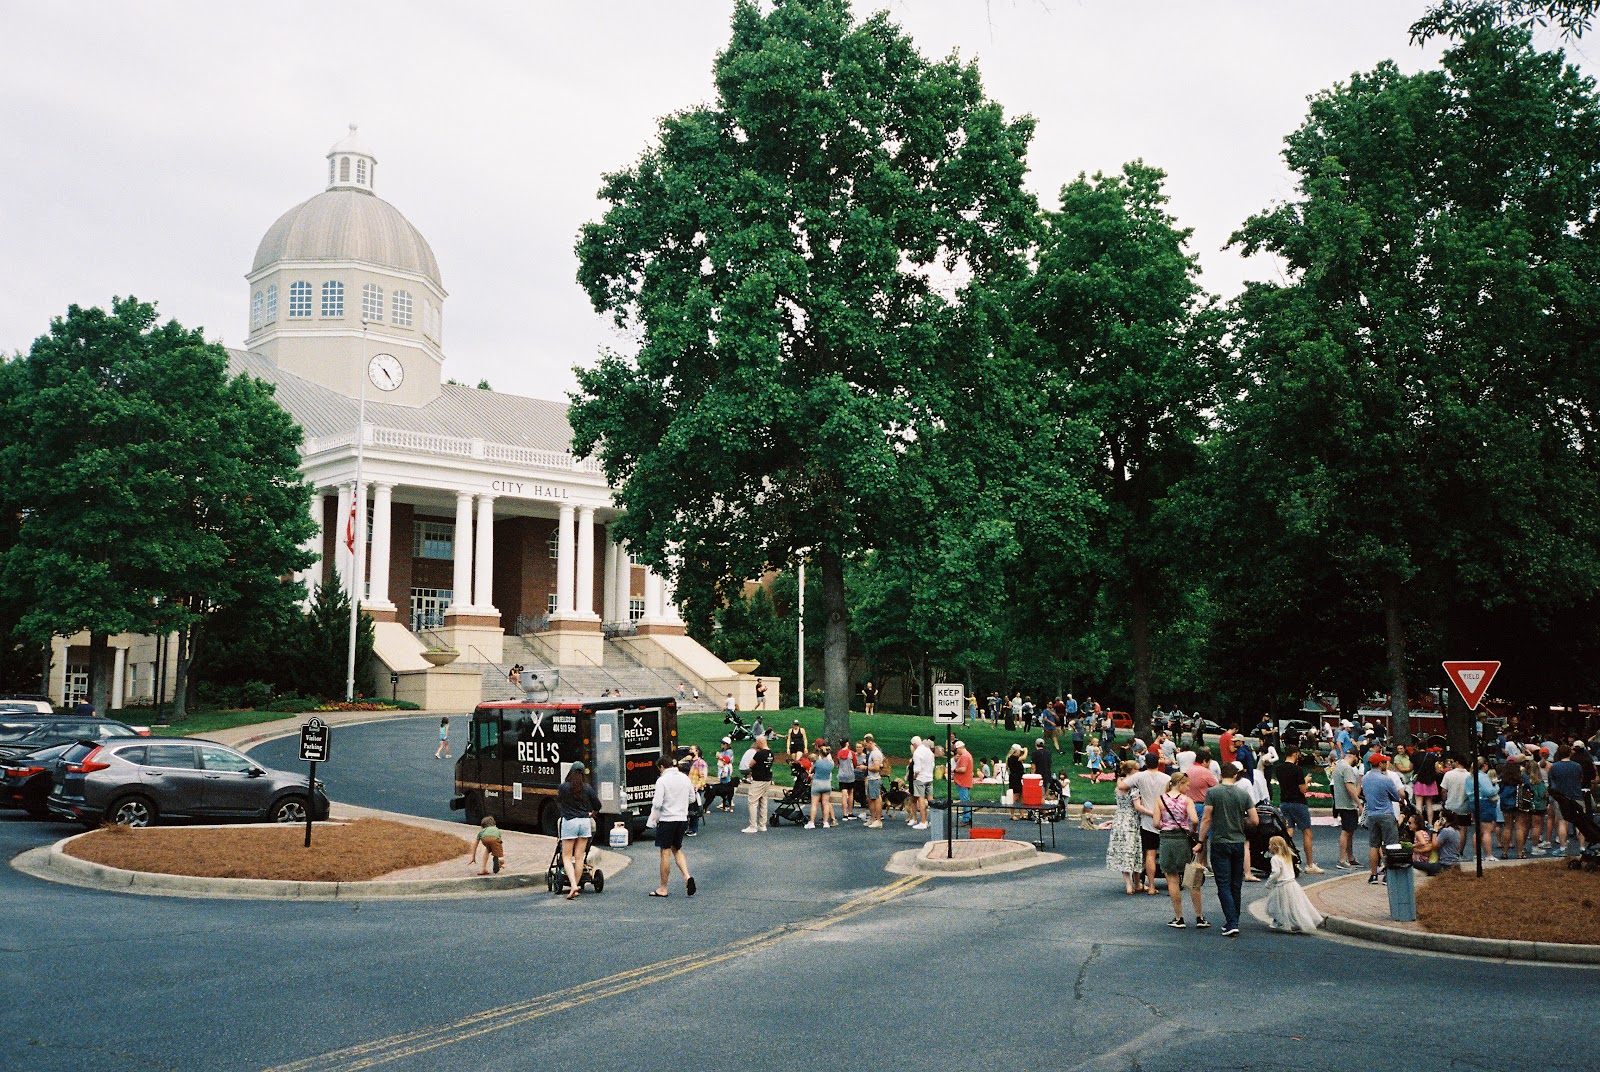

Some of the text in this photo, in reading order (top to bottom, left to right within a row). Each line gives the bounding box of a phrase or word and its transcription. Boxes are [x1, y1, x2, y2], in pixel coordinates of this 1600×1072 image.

[492, 480, 569, 499] CITY HALL
[938, 689, 960, 697] KEEP
[938, 699, 960, 707] RIGHT
[305, 734, 323, 742] Visitor
[624, 727, 653, 739] RELL'S
[303, 742, 323, 752] Parking
[517, 741, 560, 764] RELL'S
[522, 764, 555, 775] EST. 2020
[634, 790, 644, 800] 913
